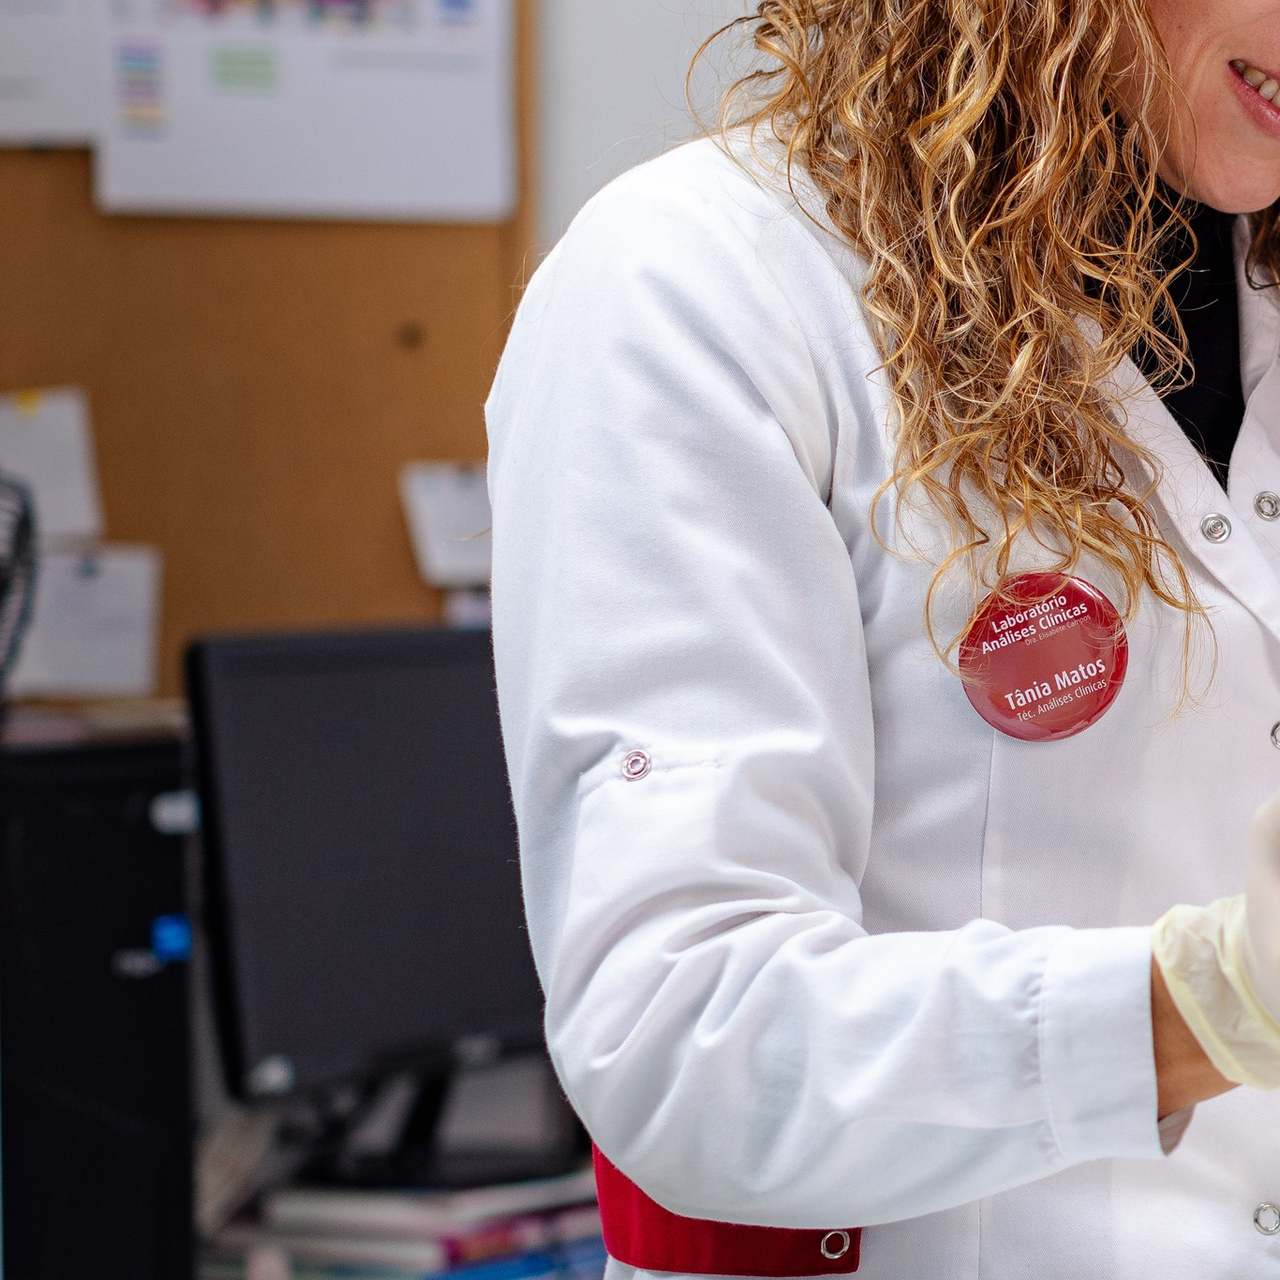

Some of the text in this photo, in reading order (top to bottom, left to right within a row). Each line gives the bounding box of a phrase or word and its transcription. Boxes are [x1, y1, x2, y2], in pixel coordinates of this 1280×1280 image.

[982, 602, 1087, 654] Análises Clínicas
[992, 595, 1067, 633] Laboratório
[1004, 658, 1105, 710] Tânia Matos
[1017, 678, 1107, 722] Téc. Análises Clínicas
